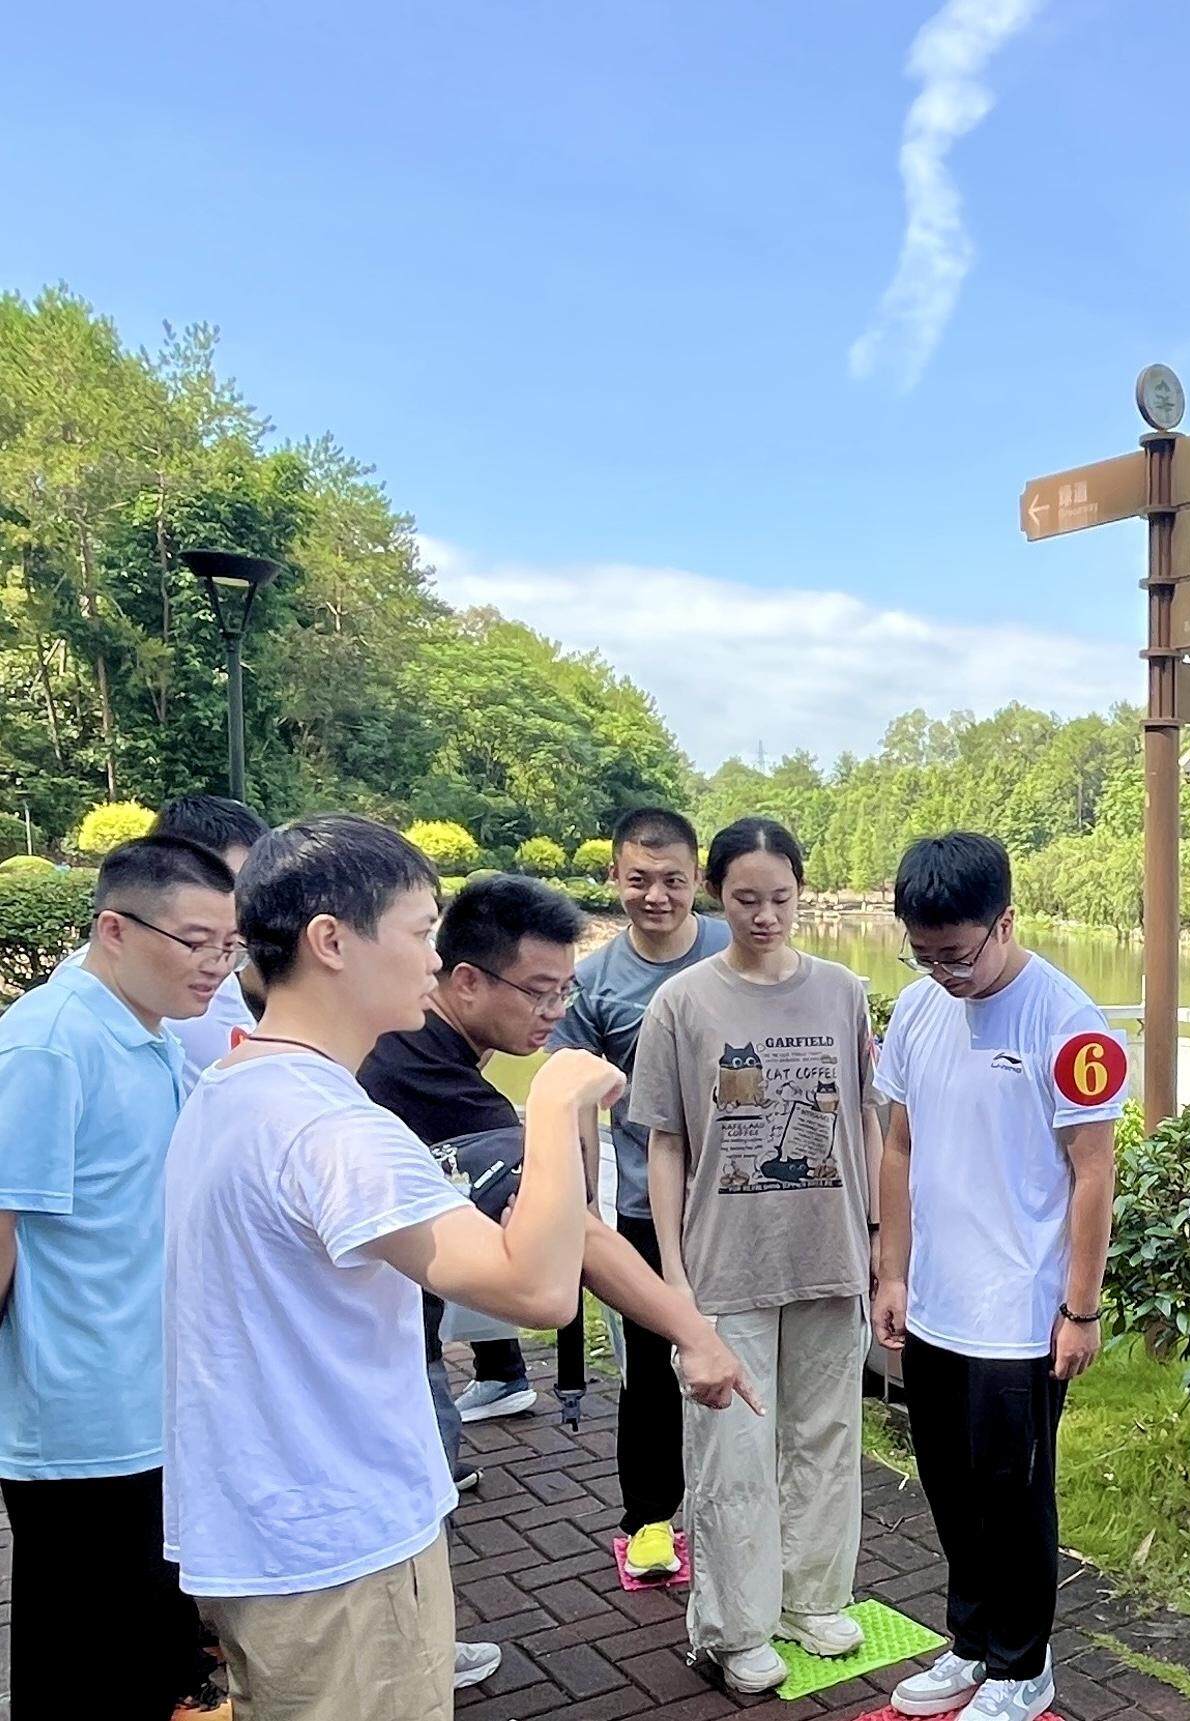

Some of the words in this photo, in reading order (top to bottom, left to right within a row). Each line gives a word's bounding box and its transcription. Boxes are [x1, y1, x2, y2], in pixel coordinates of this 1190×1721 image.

[765, 1036, 834, 1048] GARFIELD
[766, 1068, 790, 1080] CAT
[796, 1067, 837, 1079] COFFEE
[1073, 1042, 1108, 1096] 6
